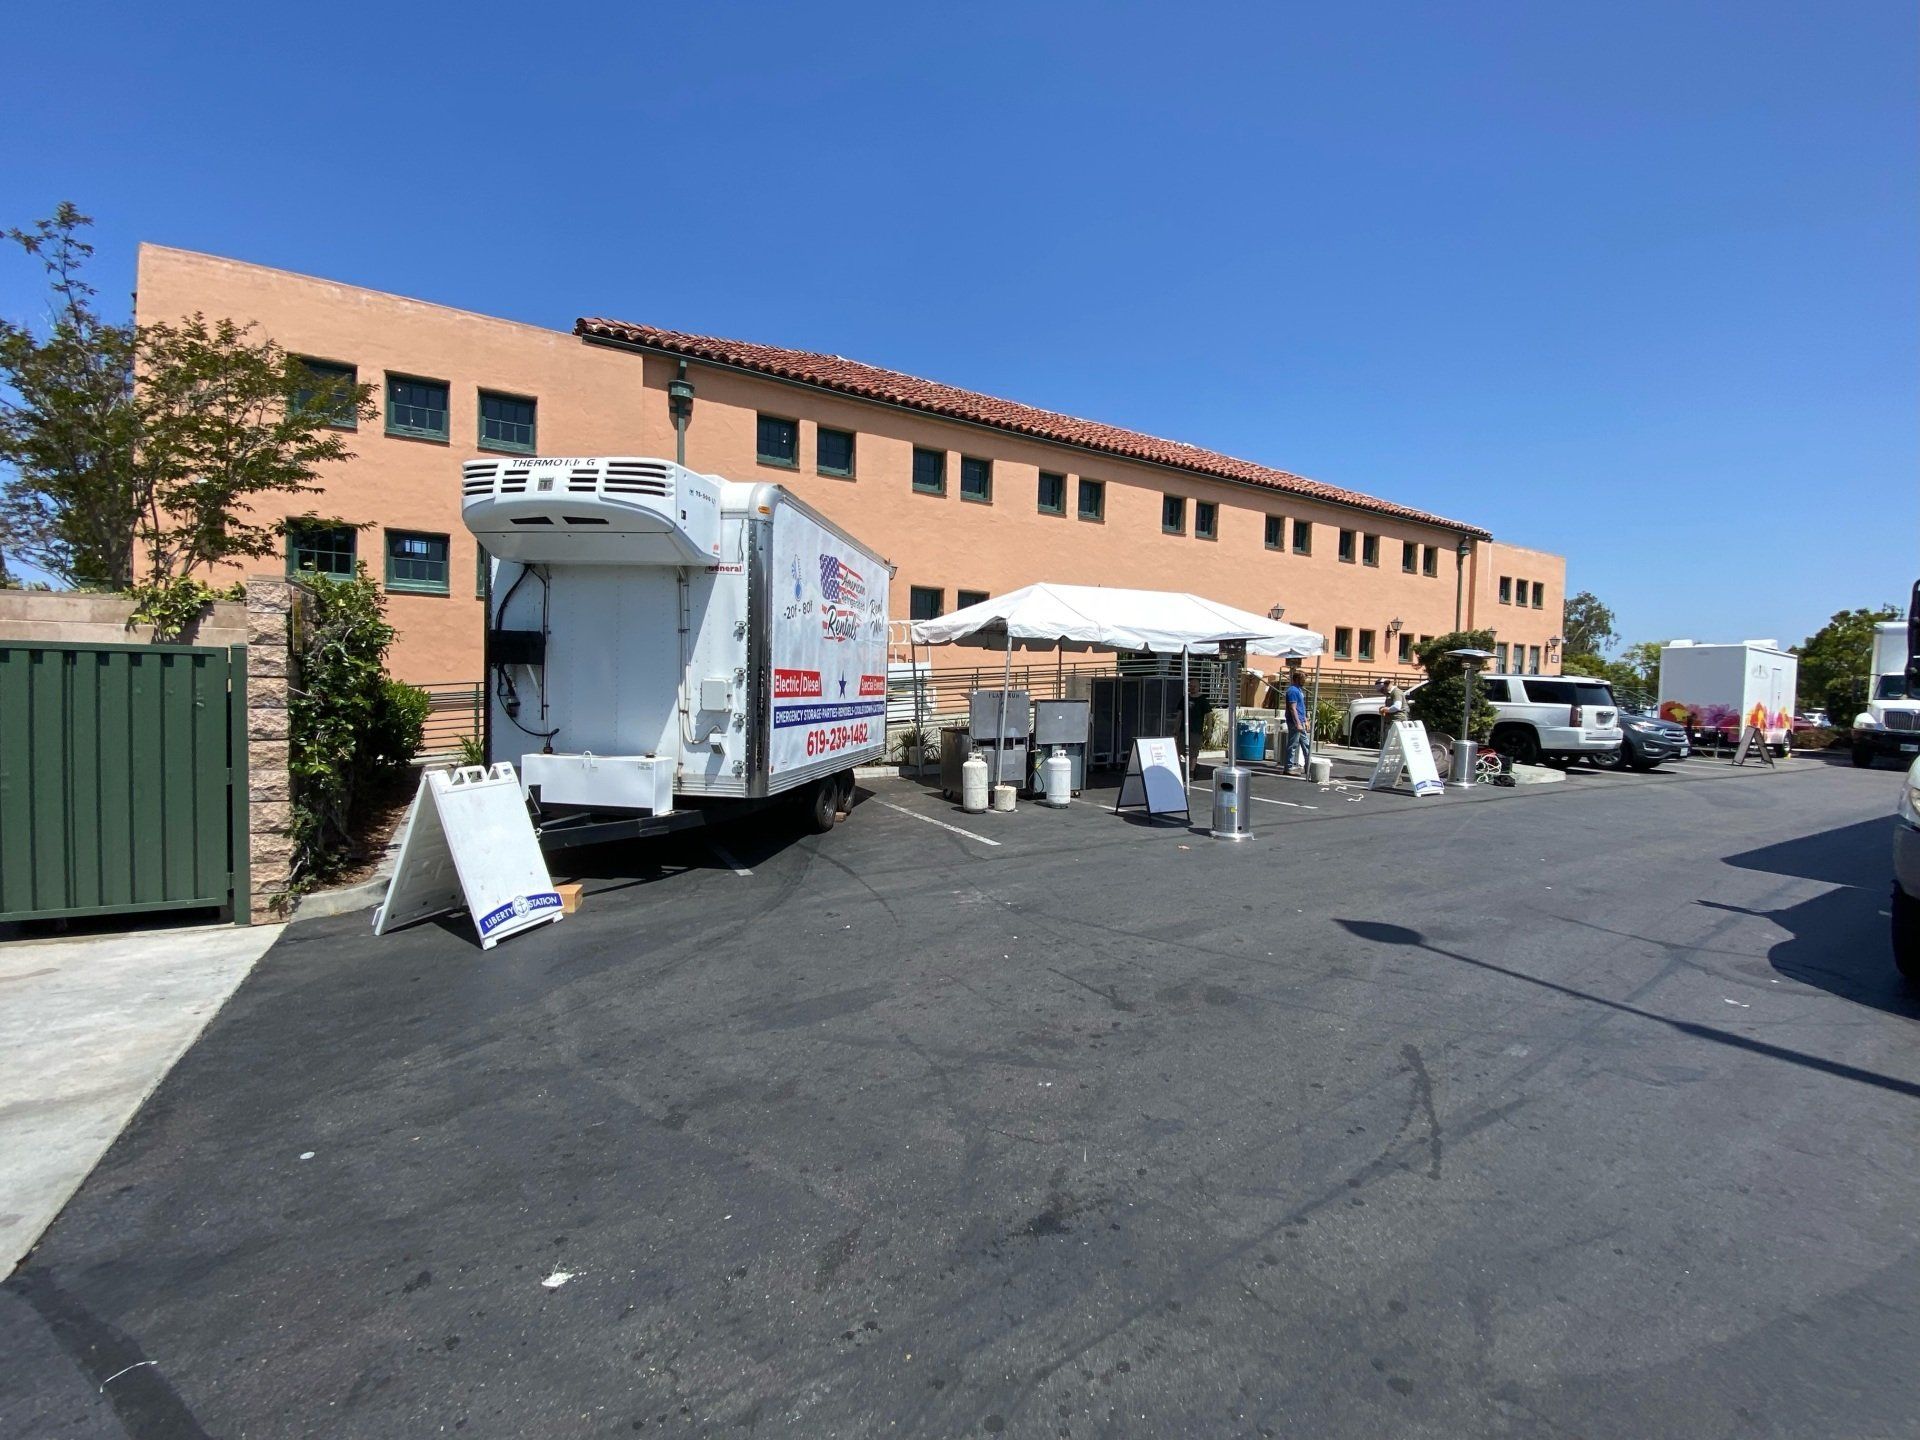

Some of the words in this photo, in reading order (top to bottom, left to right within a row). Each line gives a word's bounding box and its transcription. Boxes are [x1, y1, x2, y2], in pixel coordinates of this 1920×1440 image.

[512, 459, 563, 468] THERMO
[827, 604, 858, 641] Rentals
[775, 709, 804, 724] EMERGENCY
[807, 723, 868, 756] 619-239-1482
[485, 906, 513, 928] LIBERTY
[528, 896, 557, 909] STATION
